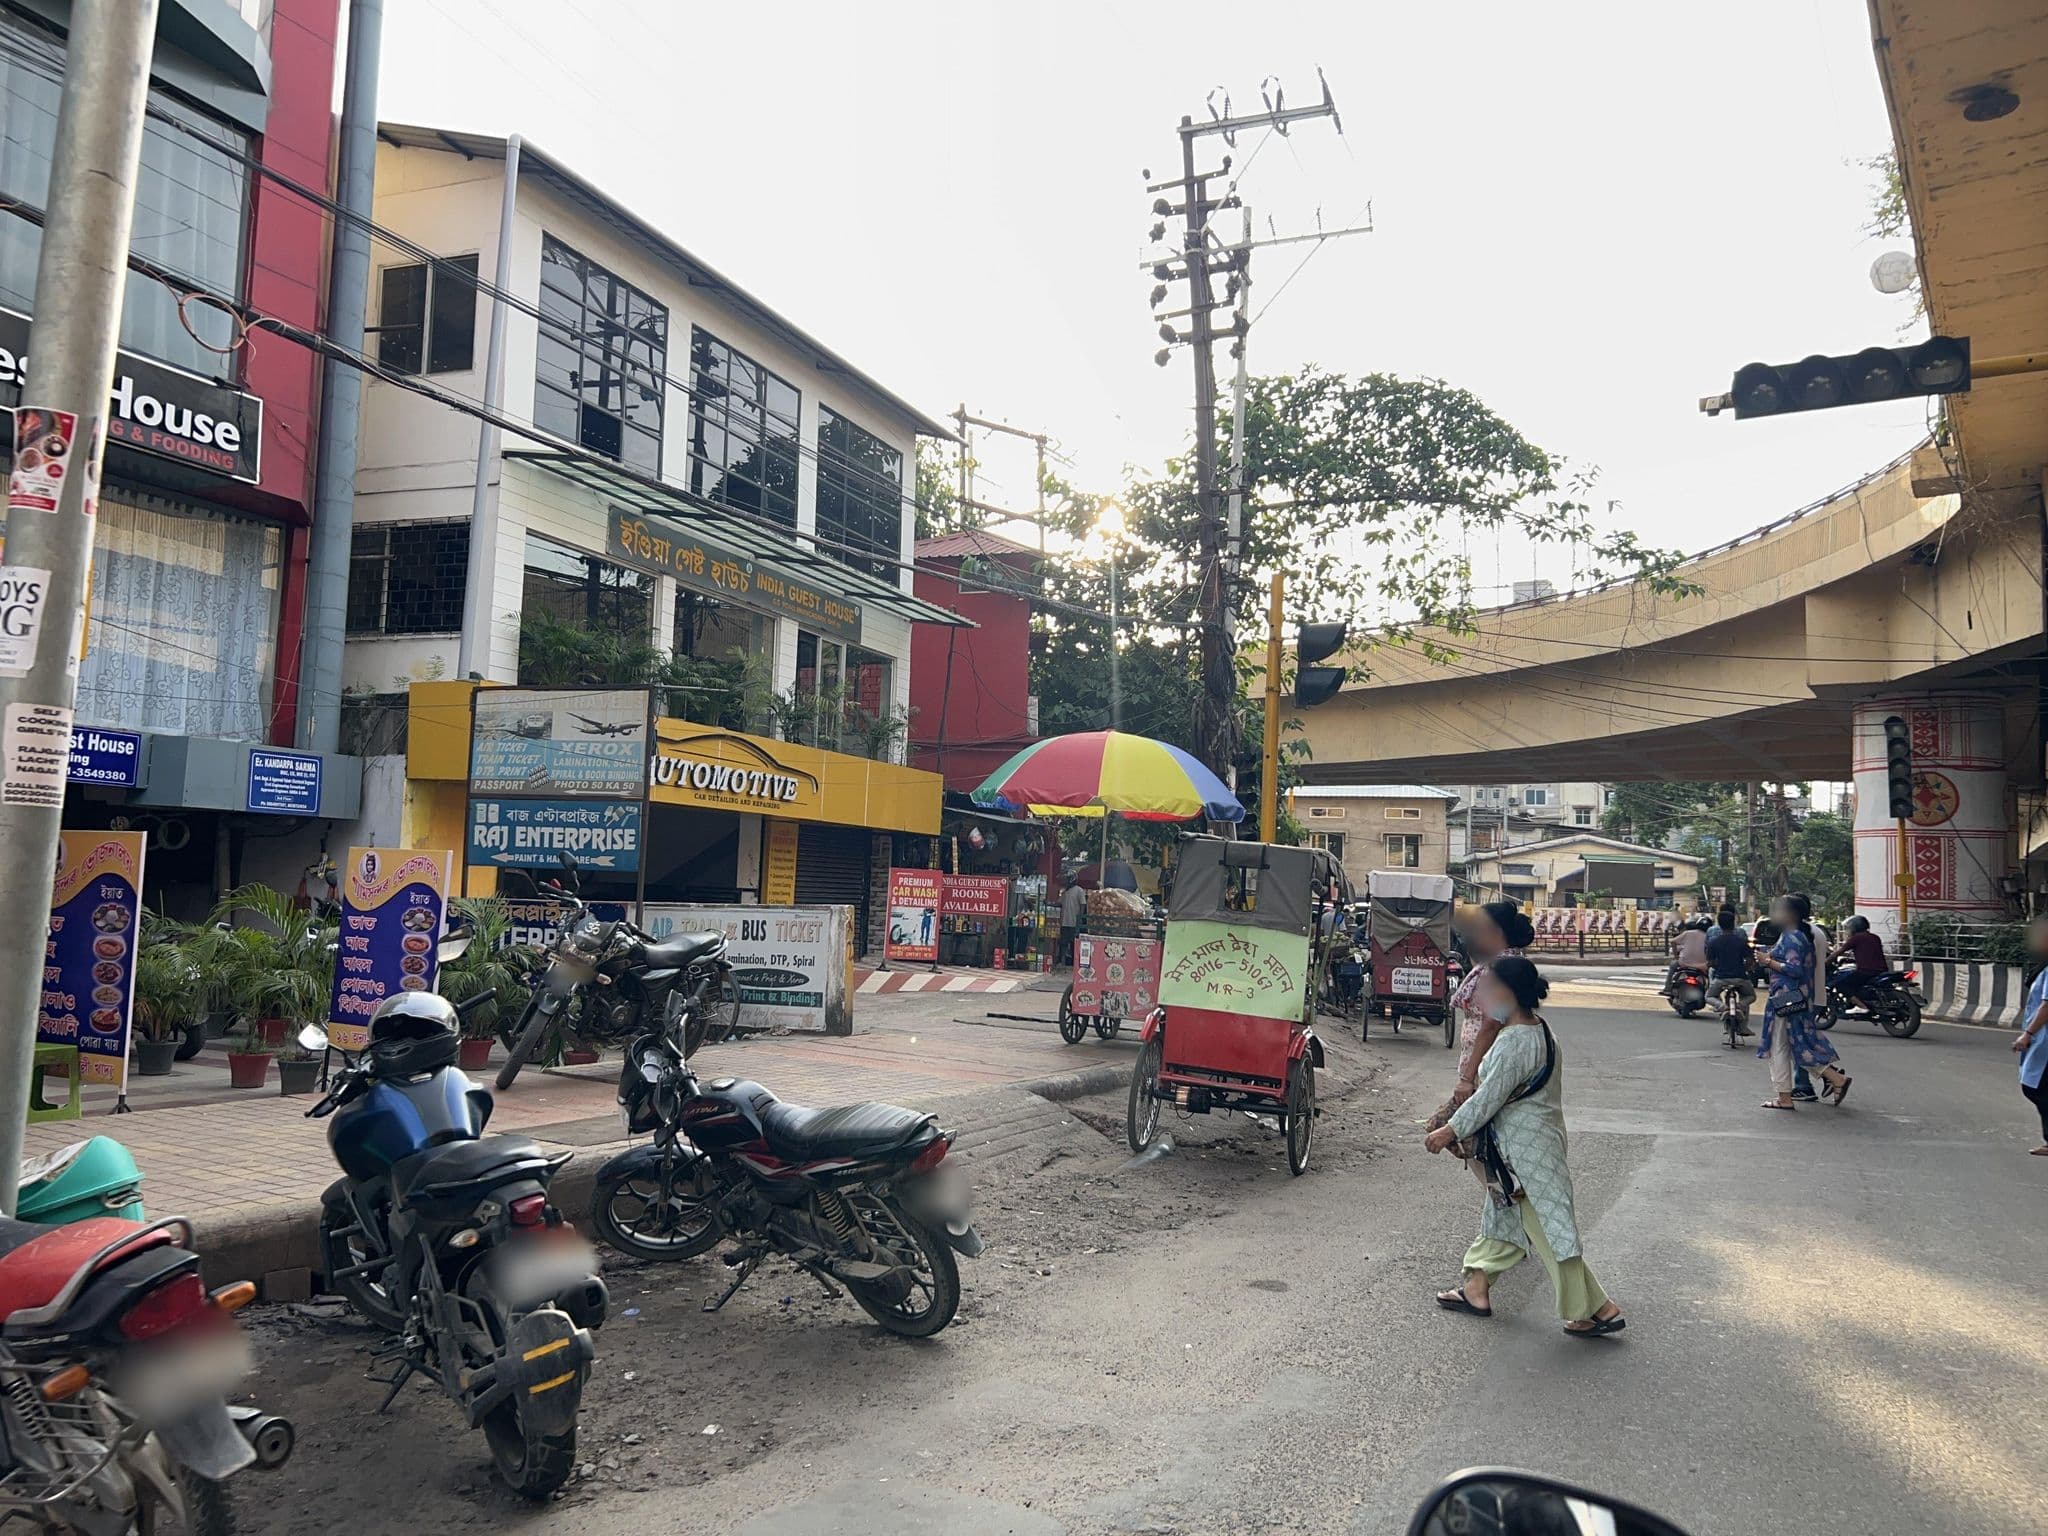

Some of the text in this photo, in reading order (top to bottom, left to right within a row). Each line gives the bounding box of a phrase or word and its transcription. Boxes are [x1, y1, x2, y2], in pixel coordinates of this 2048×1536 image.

[110, 375, 241, 451] House
[130, 426, 145, 443] &
[151, 430, 236, 470] FOODING
[756, 572, 785, 598] INDIA
[788, 585, 821, 612] GUEST
[824, 599, 855, 625] HOUSE
[87, 733, 135, 755] House
[497, 742, 528, 753] TICKET
[558, 741, 636, 756] XEROX
[477, 754, 541, 765] TRAIN TICKET
[498, 766, 529, 777] PRINT
[474, 780, 635, 791] PASSPORT PHOTO 50 KA 50
[473, 824, 637, 851] RAJ ENTERPRISE
[514, 854, 537, 863] PAINT
[539, 855, 545, 863] &
[898, 876, 935, 888] PREMIUM
[958, 878, 980, 888] GUEST
[980, 879, 1002, 889] HOUSE
[892, 886, 939, 899] CAR WASH
[952, 888, 990, 900] ROOMS
[891, 896, 939, 908] & DETAILING
[942, 901, 1000, 913] AVAILABLE
[347, 914, 378, 931] ভাত
[651, 917, 674, 937] AIR
[726, 921, 738, 941] &
[741, 919, 768, 942] BUS
[776, 919, 824, 943] TICKET
[345, 935, 370, 953] মাছ
[770, 955, 790, 968] DTP,
[793, 955, 816, 968] Spiral
[341, 977, 386, 996] পোলাও
[1393, 978, 1431, 987] GOLD LOAN
[742, 990, 765, 1001] Print
[768, 993, 778, 1002] &
[780, 991, 817, 1006] Binding
